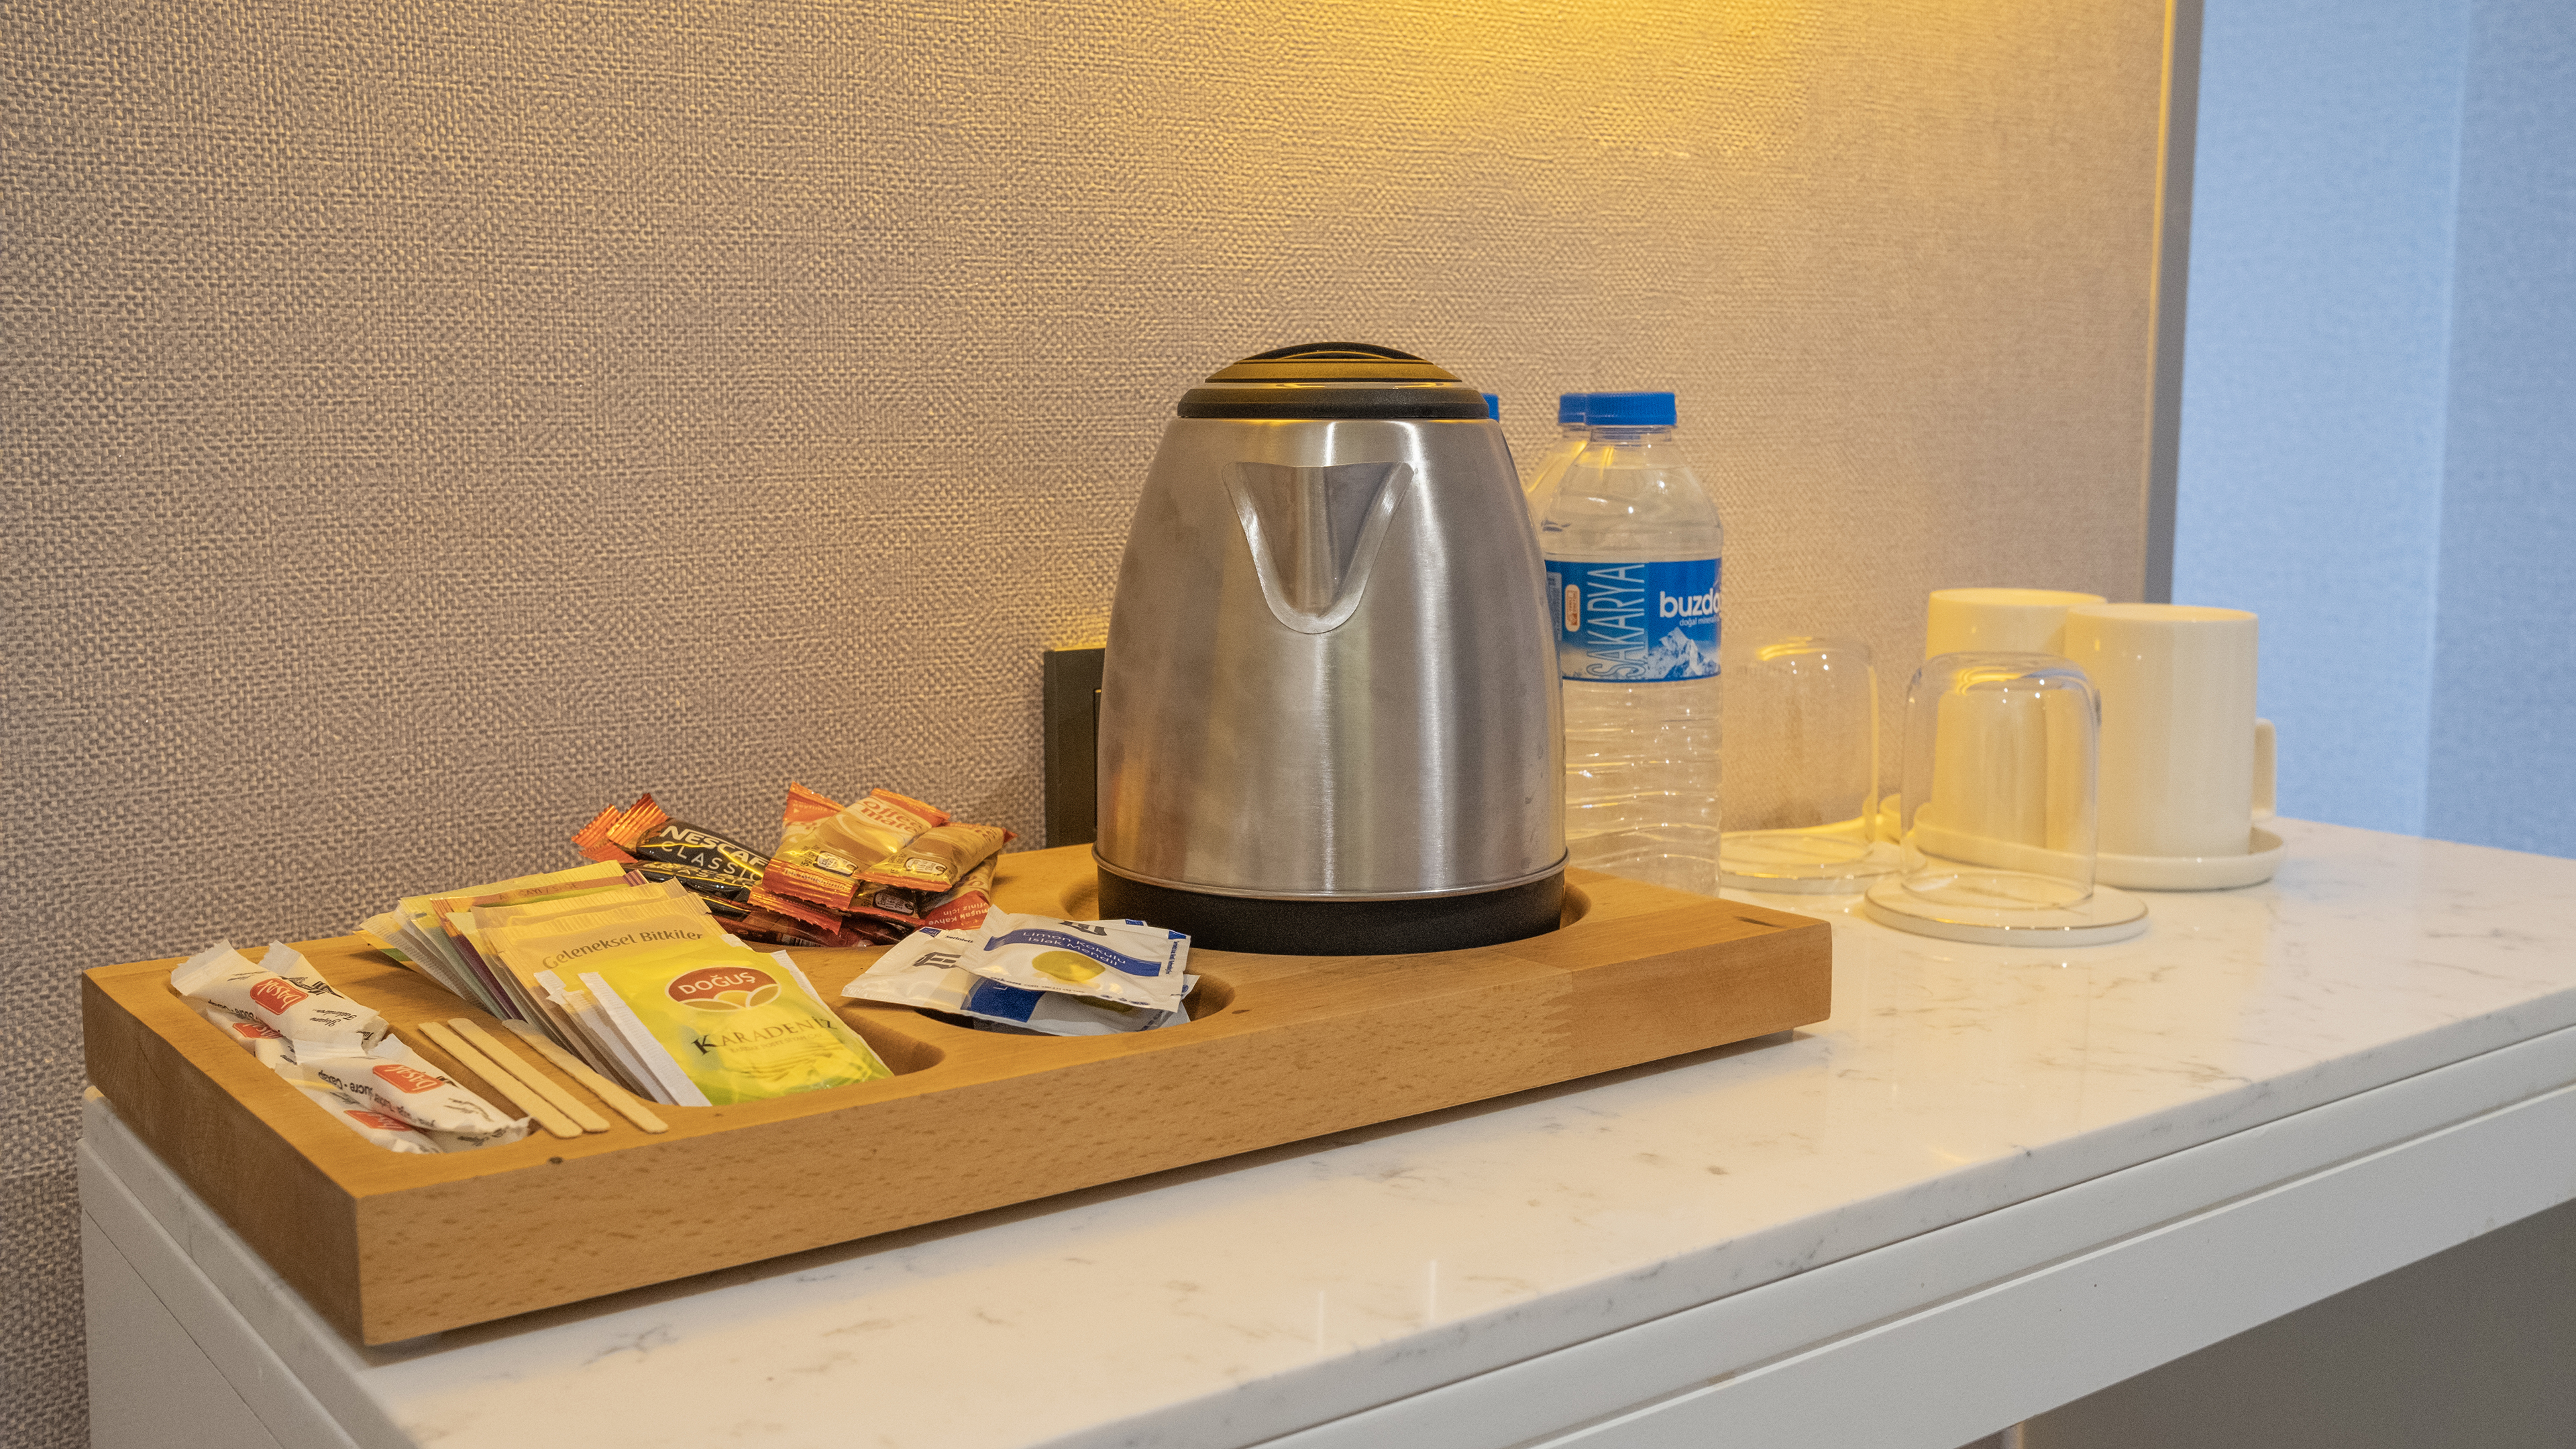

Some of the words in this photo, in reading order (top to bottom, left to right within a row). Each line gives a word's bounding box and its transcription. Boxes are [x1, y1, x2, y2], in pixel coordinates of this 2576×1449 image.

[1587, 564, 1646, 678] SAKARYA
[863, 800, 922, 830] offee
[659, 826, 769, 867] NESCAF
[959, 908, 990, 920] muşak
[542, 934, 637, 969] Geleneksel
[639, 929, 703, 942] Bitkiler
[1023, 931, 1071, 943] Limon
[1077, 941, 1126, 964] Kokulu
[1028, 936, 1062, 946] Islak
[1067, 943, 1117, 966] Mendil
[678, 972, 756, 994] DOĞUŞ
